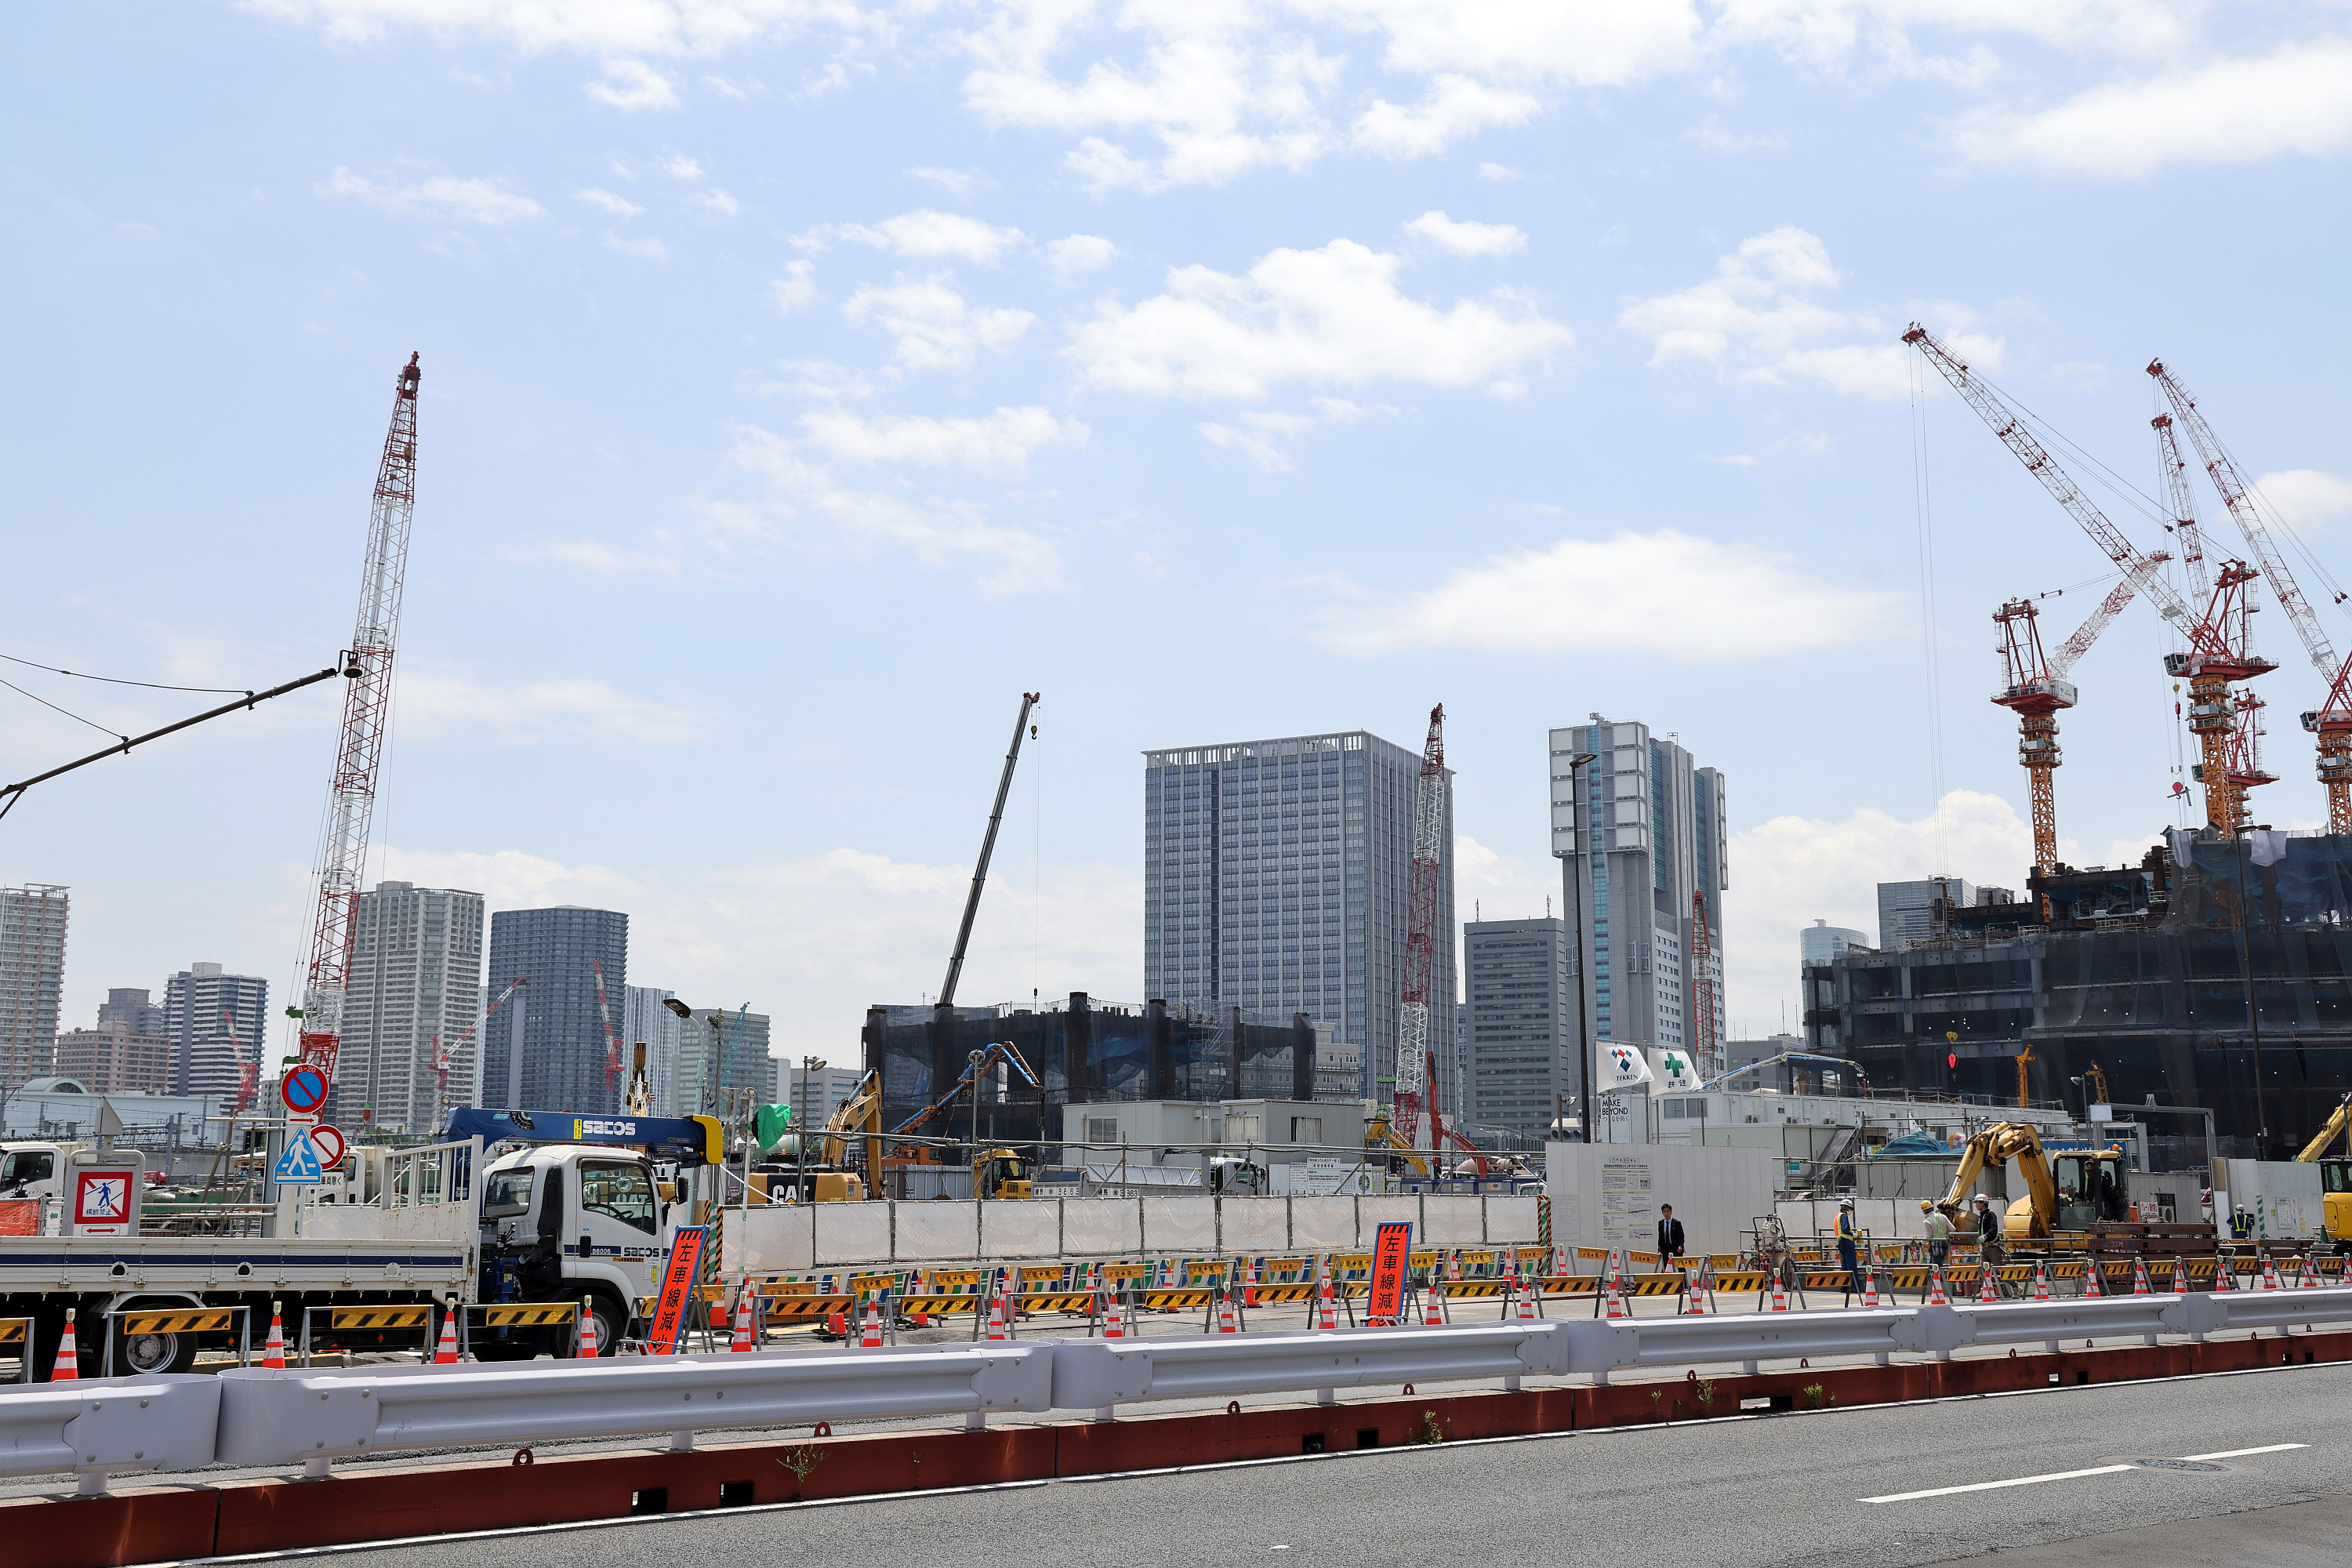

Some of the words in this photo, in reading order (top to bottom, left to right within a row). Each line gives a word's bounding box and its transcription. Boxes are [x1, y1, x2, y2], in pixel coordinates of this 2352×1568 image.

[1602, 1098, 1621, 1107] MAKE
[772, 1185, 809, 1203] CAT
[655, 1243, 694, 1353] 左車線減少
